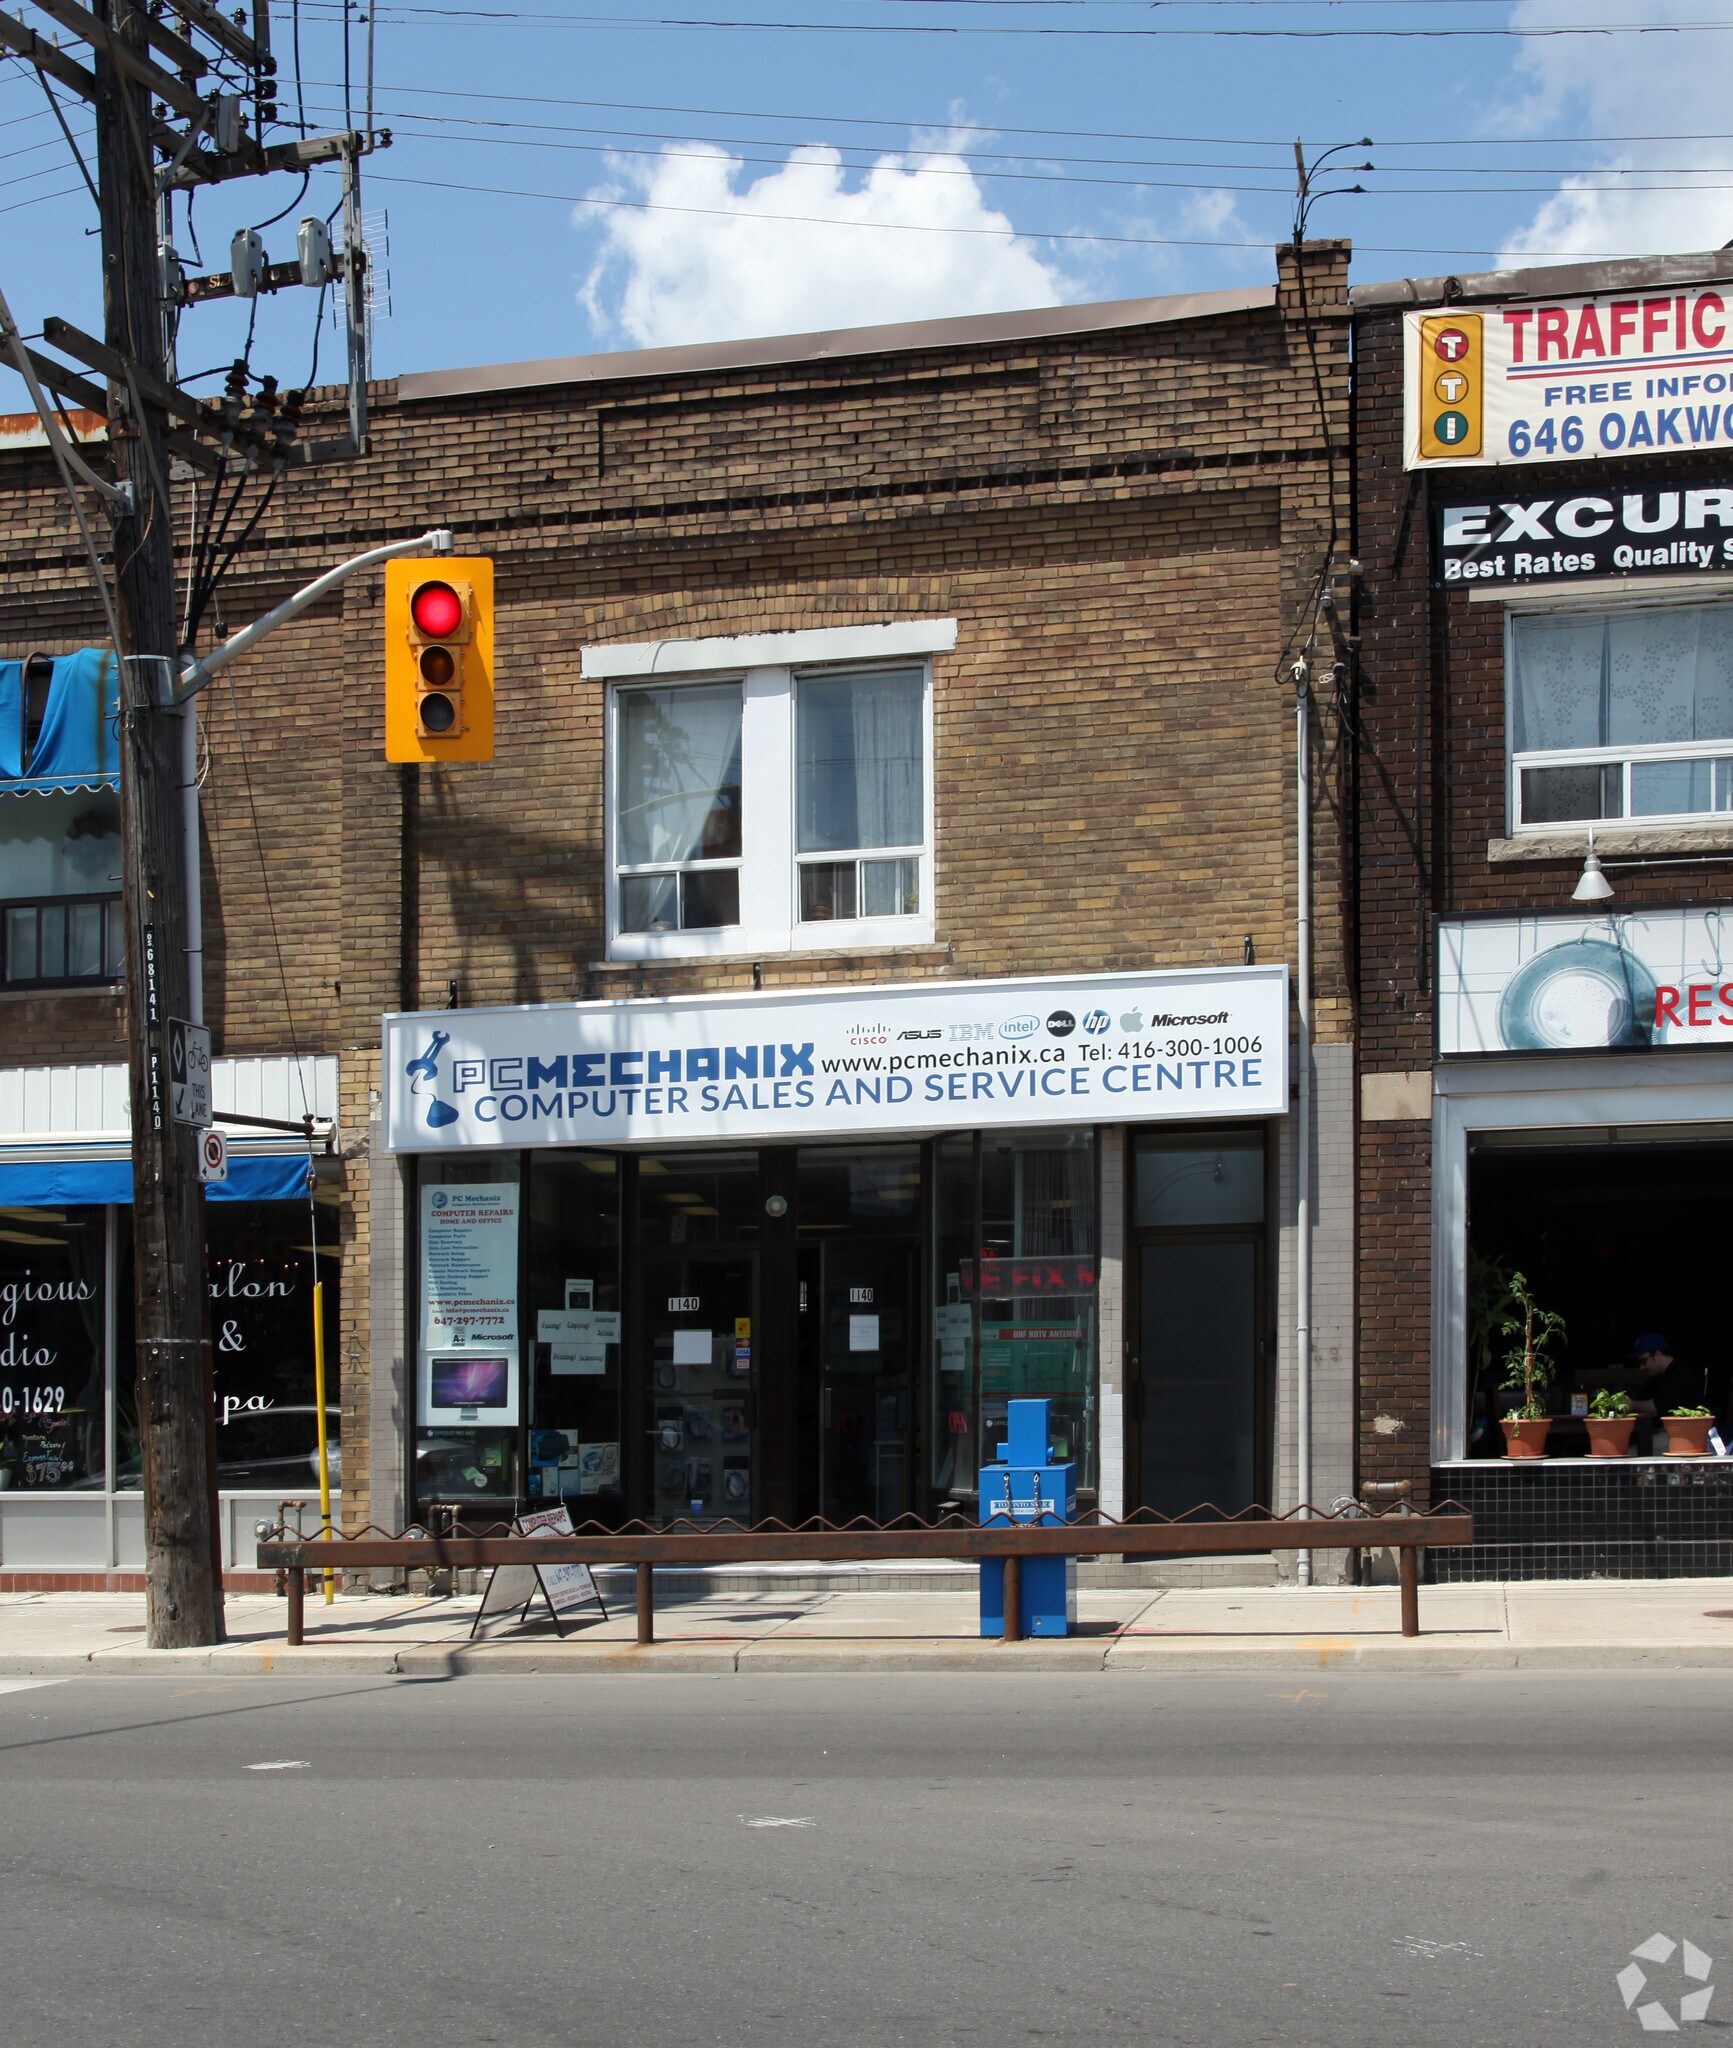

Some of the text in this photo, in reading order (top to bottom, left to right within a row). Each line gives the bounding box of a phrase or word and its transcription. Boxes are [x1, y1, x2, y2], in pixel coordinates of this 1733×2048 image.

[1503, 292, 1726, 363] TRAFFIC
[1441, 336, 1462, 358] T
[1441, 378, 1463, 400] T
[1545, 373, 1733, 407] FREE INFO
[1508, 415, 1584, 457] 646
[1443, 489, 1733, 546] EXCUR
[1444, 556, 1505, 580] Best
[1514, 552, 1596, 576] Rates
[1613, 541, 1714, 568] Quality
[1656, 983, 1733, 1028] RES
[948, 1023, 995, 1042] IBM
[1151, 1011, 1229, 1027] Microsoft
[822, 1036, 1263, 1074] www.pcmechanix.ca Tel: 416-300-1006
[192, 1083, 206, 1099] THIS
[474, 1058, 1263, 1122] COMPUTER SALES AND SERVICE CENTRE
[1012, 1265, 1067, 1289] FIX
[428, 1298, 515, 1307] www.pcmechanix.ca
[670, 1298, 699, 1310] 1140
[851, 1289, 873, 1301] 1140
[219, 1320, 247, 1351] &
[434, 1316, 505, 1325] 647-297-7772
[1013, 1330, 1027, 1338] UHF
[1029, 1330, 1047, 1338] HDTV
[2, 1386, 65, 1413] 0-1629
[213, 1391, 274, 1426] pa
